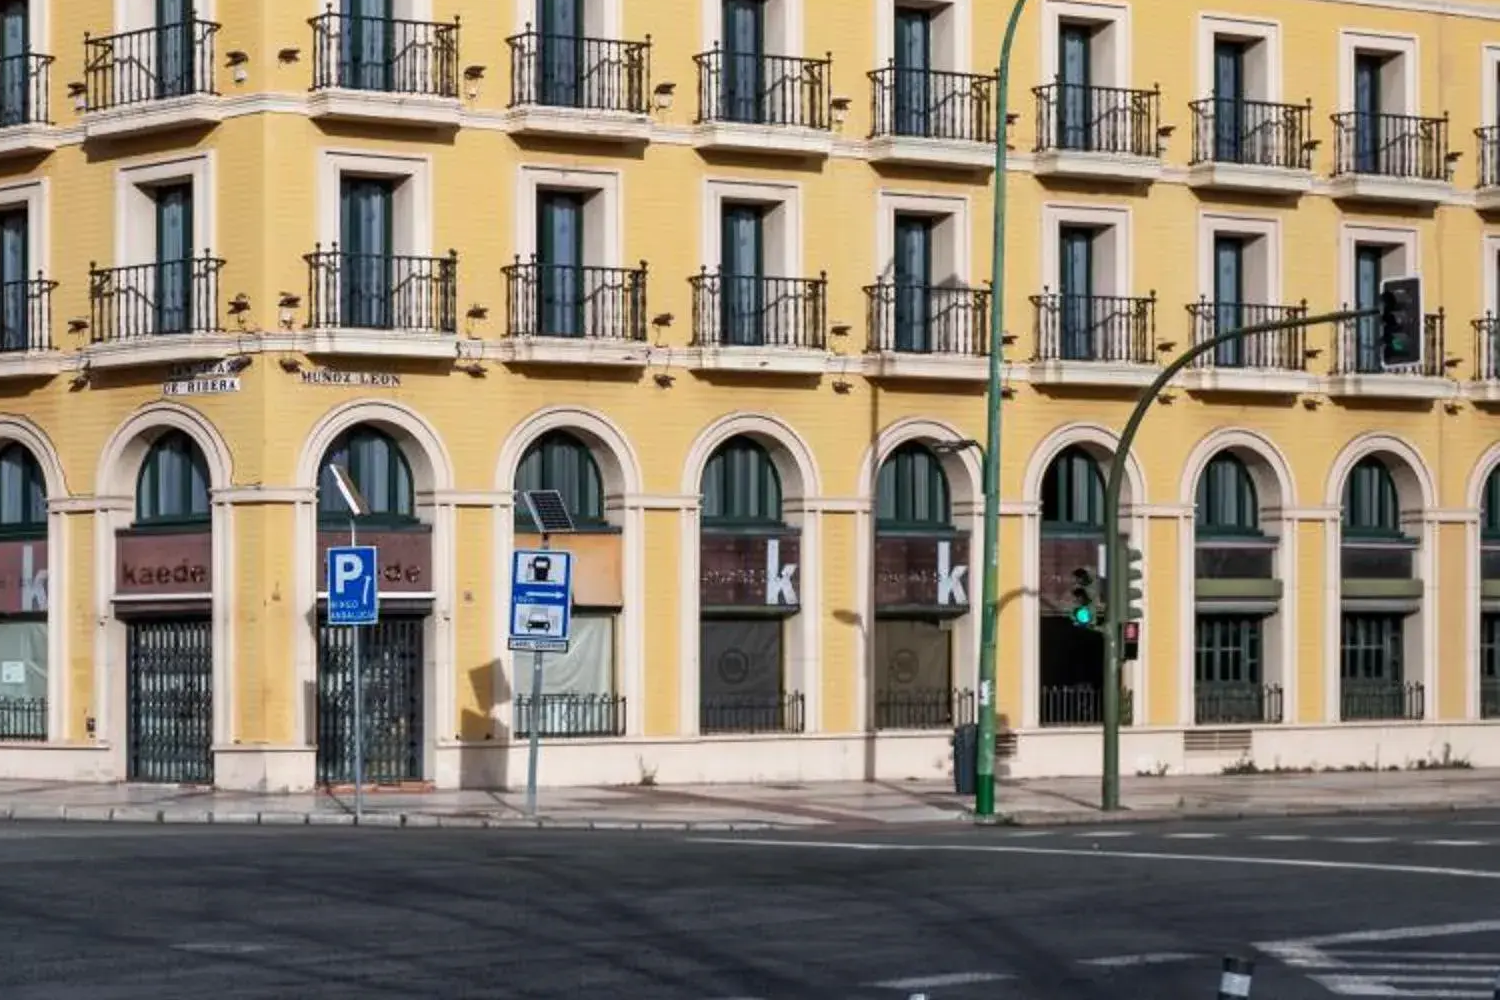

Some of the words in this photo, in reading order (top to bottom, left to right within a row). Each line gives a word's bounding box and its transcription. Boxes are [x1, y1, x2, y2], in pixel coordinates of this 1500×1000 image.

[122, 558, 207, 586] kaede
[335, 554, 363, 594] P
[766, 539, 798, 605] k
[937, 541, 968, 605] k
